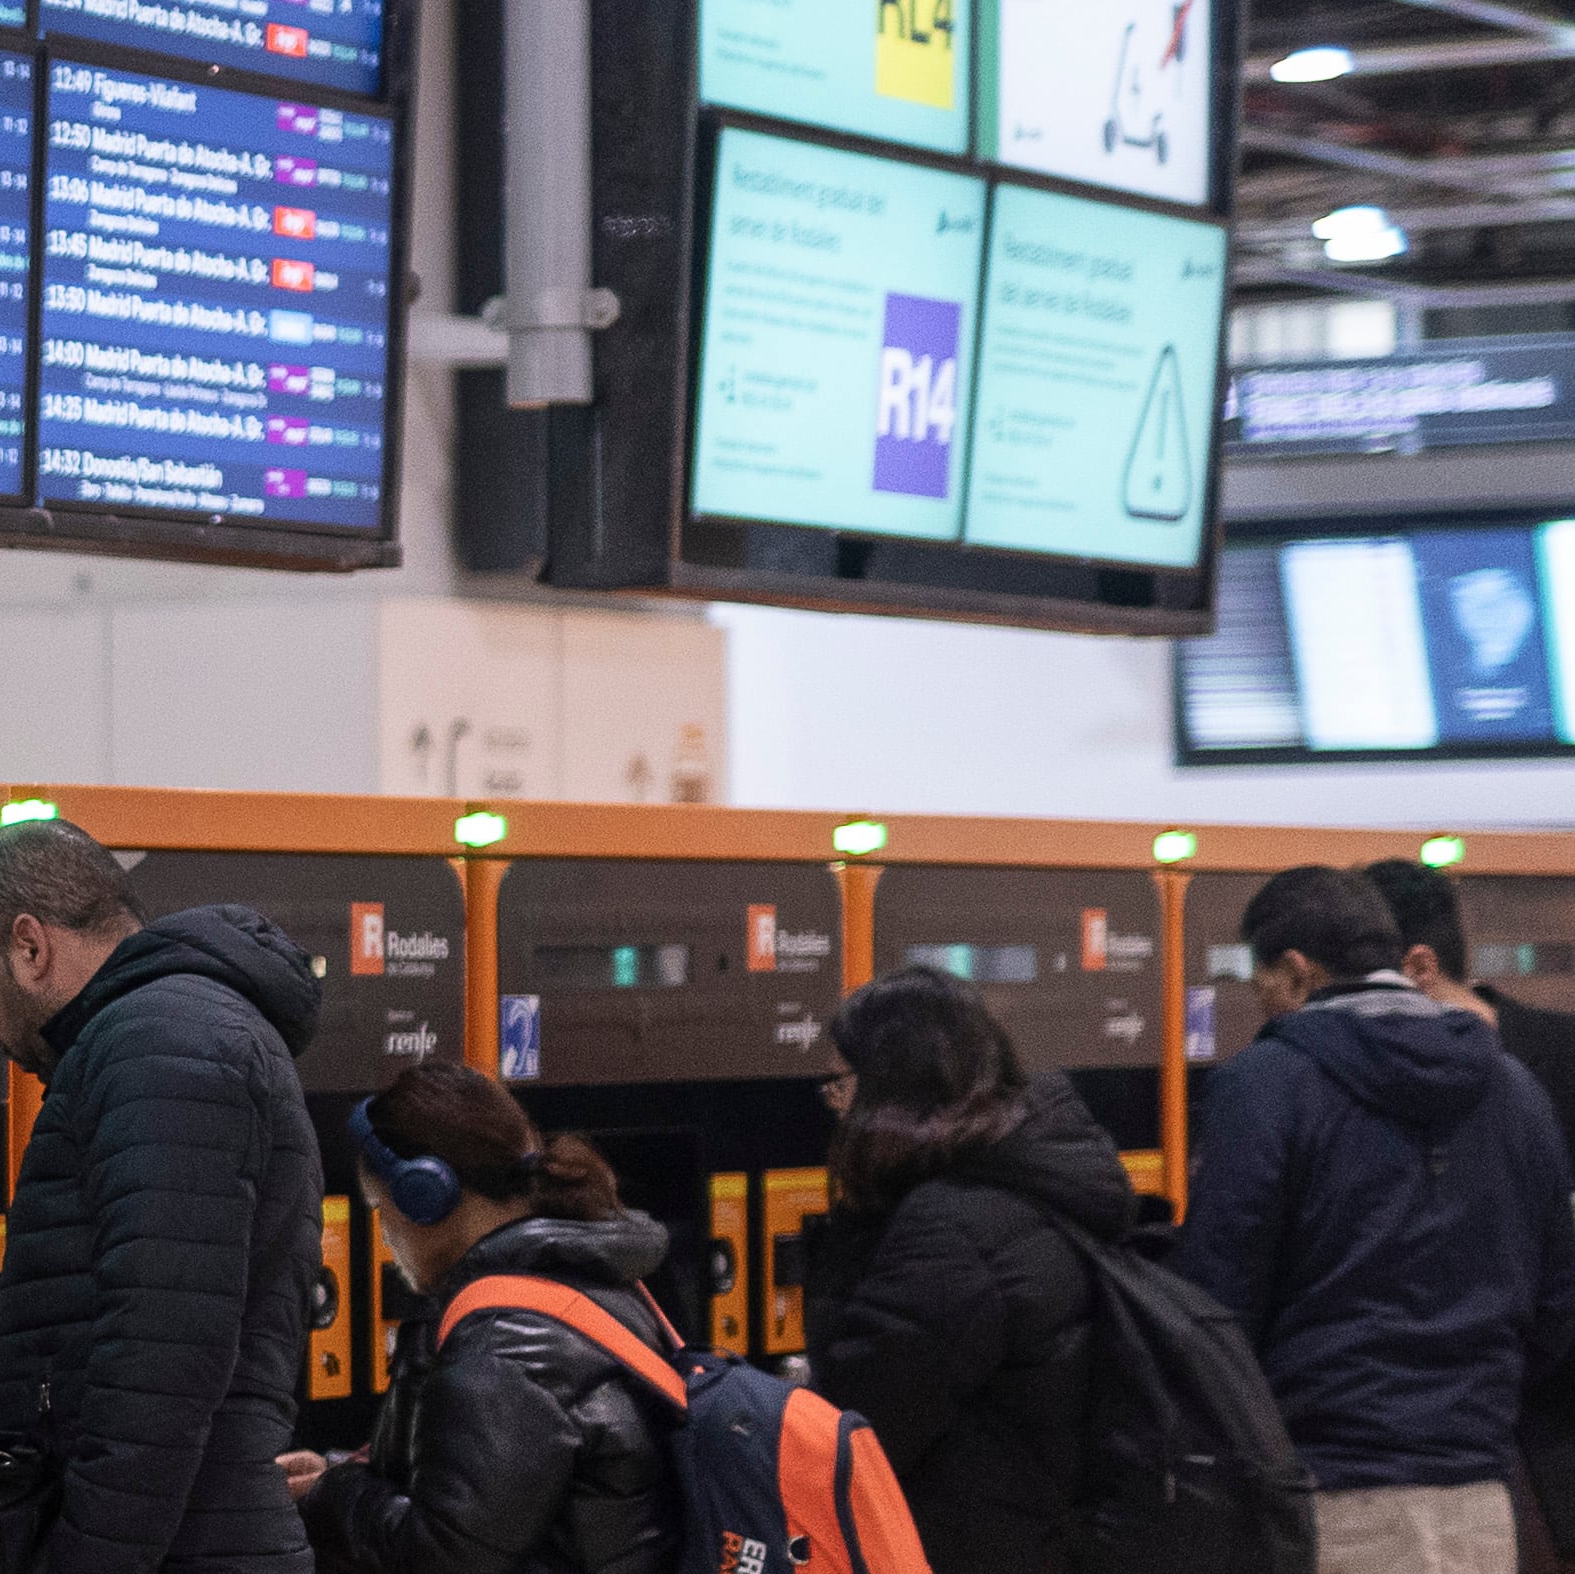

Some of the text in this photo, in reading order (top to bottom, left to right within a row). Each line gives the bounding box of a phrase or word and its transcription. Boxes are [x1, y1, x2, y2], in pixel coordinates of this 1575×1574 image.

[879, 346, 956, 446] R14
[363, 914, 384, 957] R
[387, 930, 449, 959] Rodalies
[385, 1021, 437, 1064] renfe
